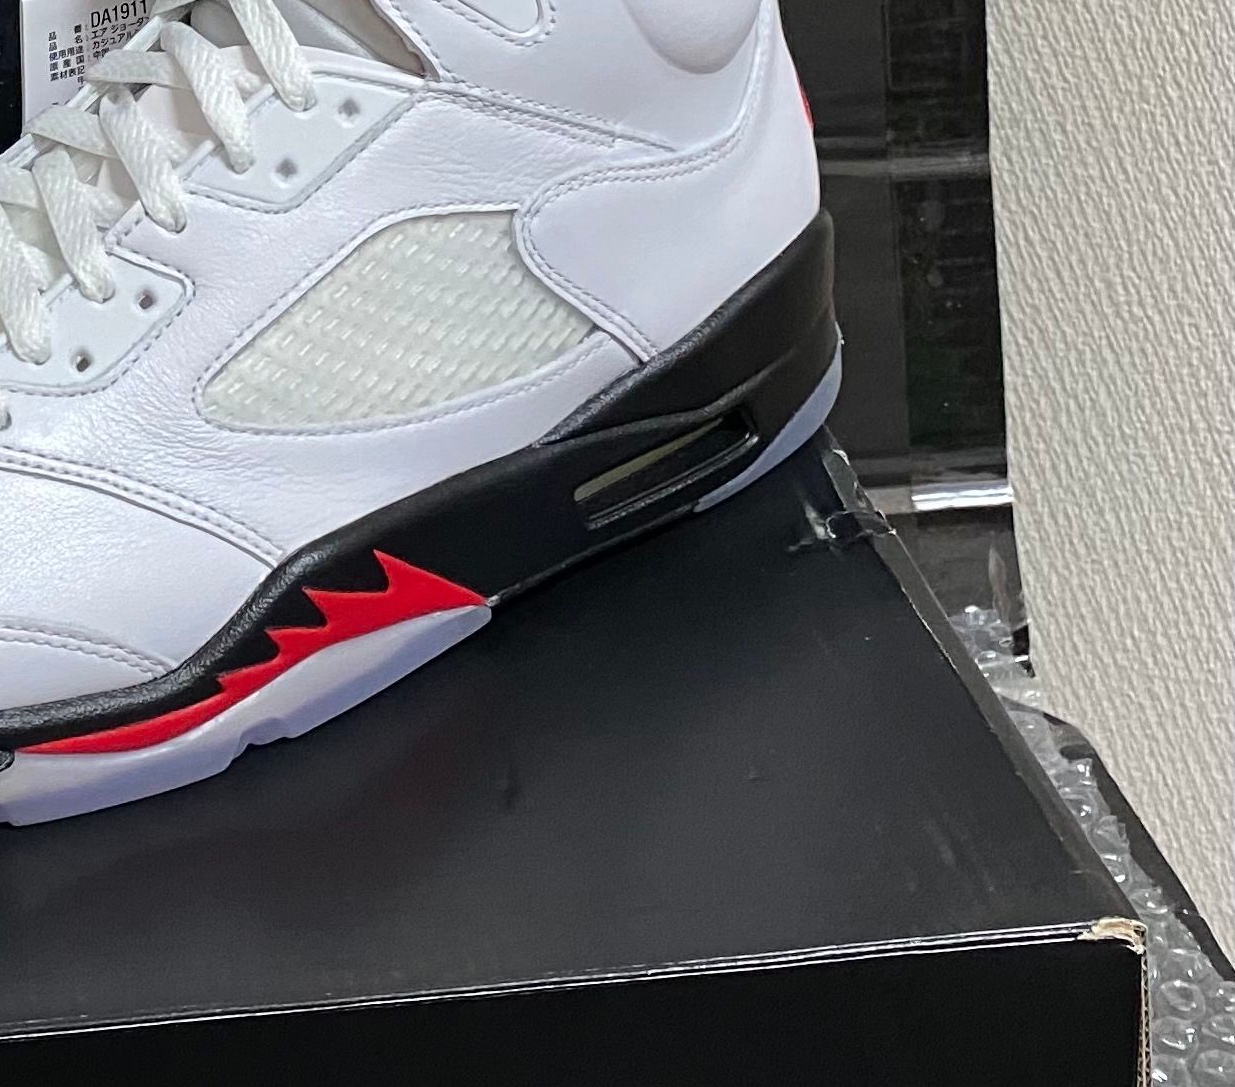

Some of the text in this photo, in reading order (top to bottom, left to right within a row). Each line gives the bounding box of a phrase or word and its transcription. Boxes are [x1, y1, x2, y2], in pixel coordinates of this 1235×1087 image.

[92, 28, 140, 50] カジュアル
